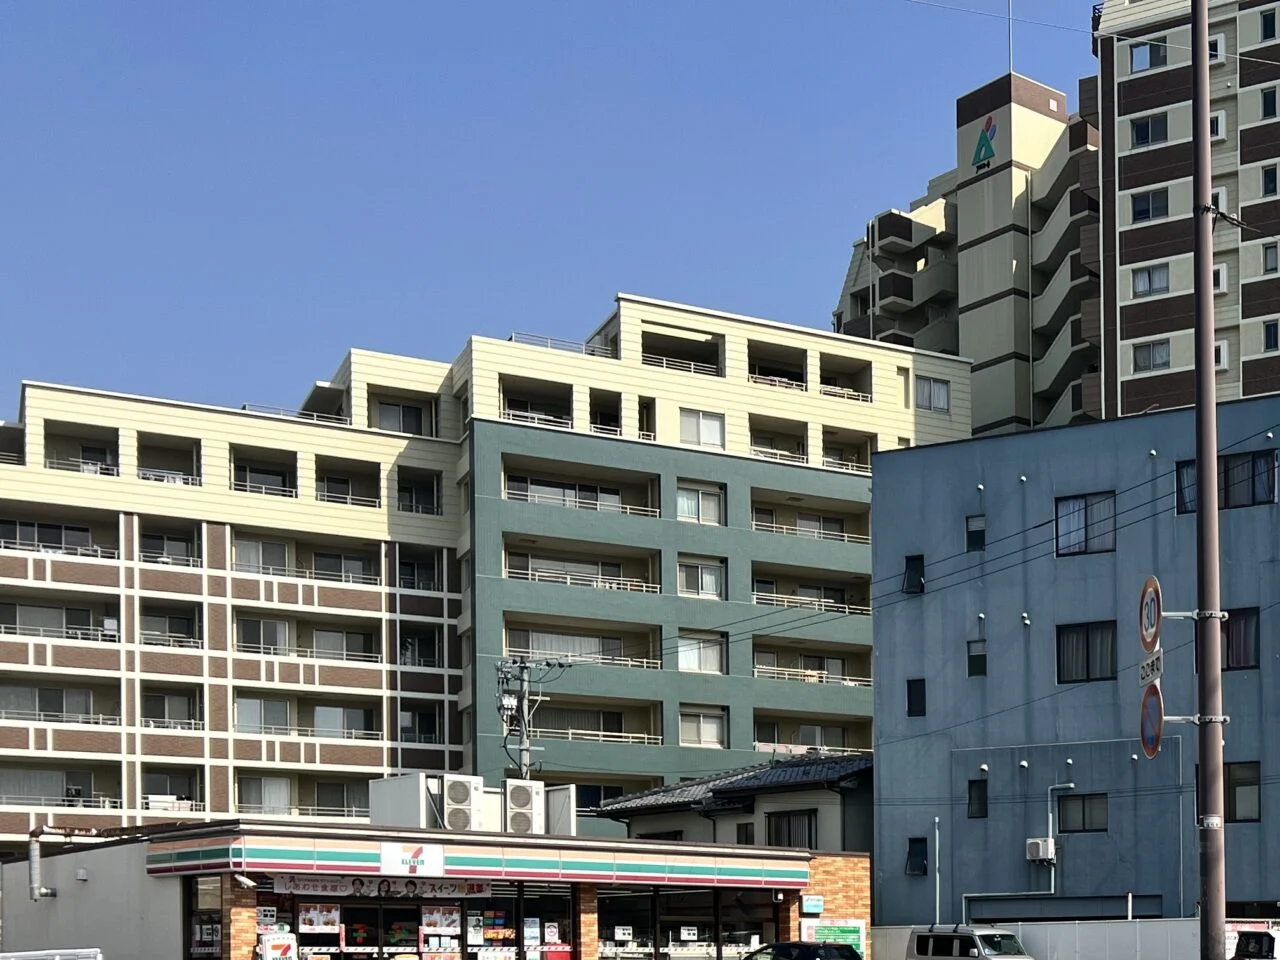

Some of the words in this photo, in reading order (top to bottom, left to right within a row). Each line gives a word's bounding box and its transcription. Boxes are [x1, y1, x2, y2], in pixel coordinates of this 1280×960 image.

[1144, 597, 1156, 632] 30
[1140, 654, 1161, 681] ここまで
